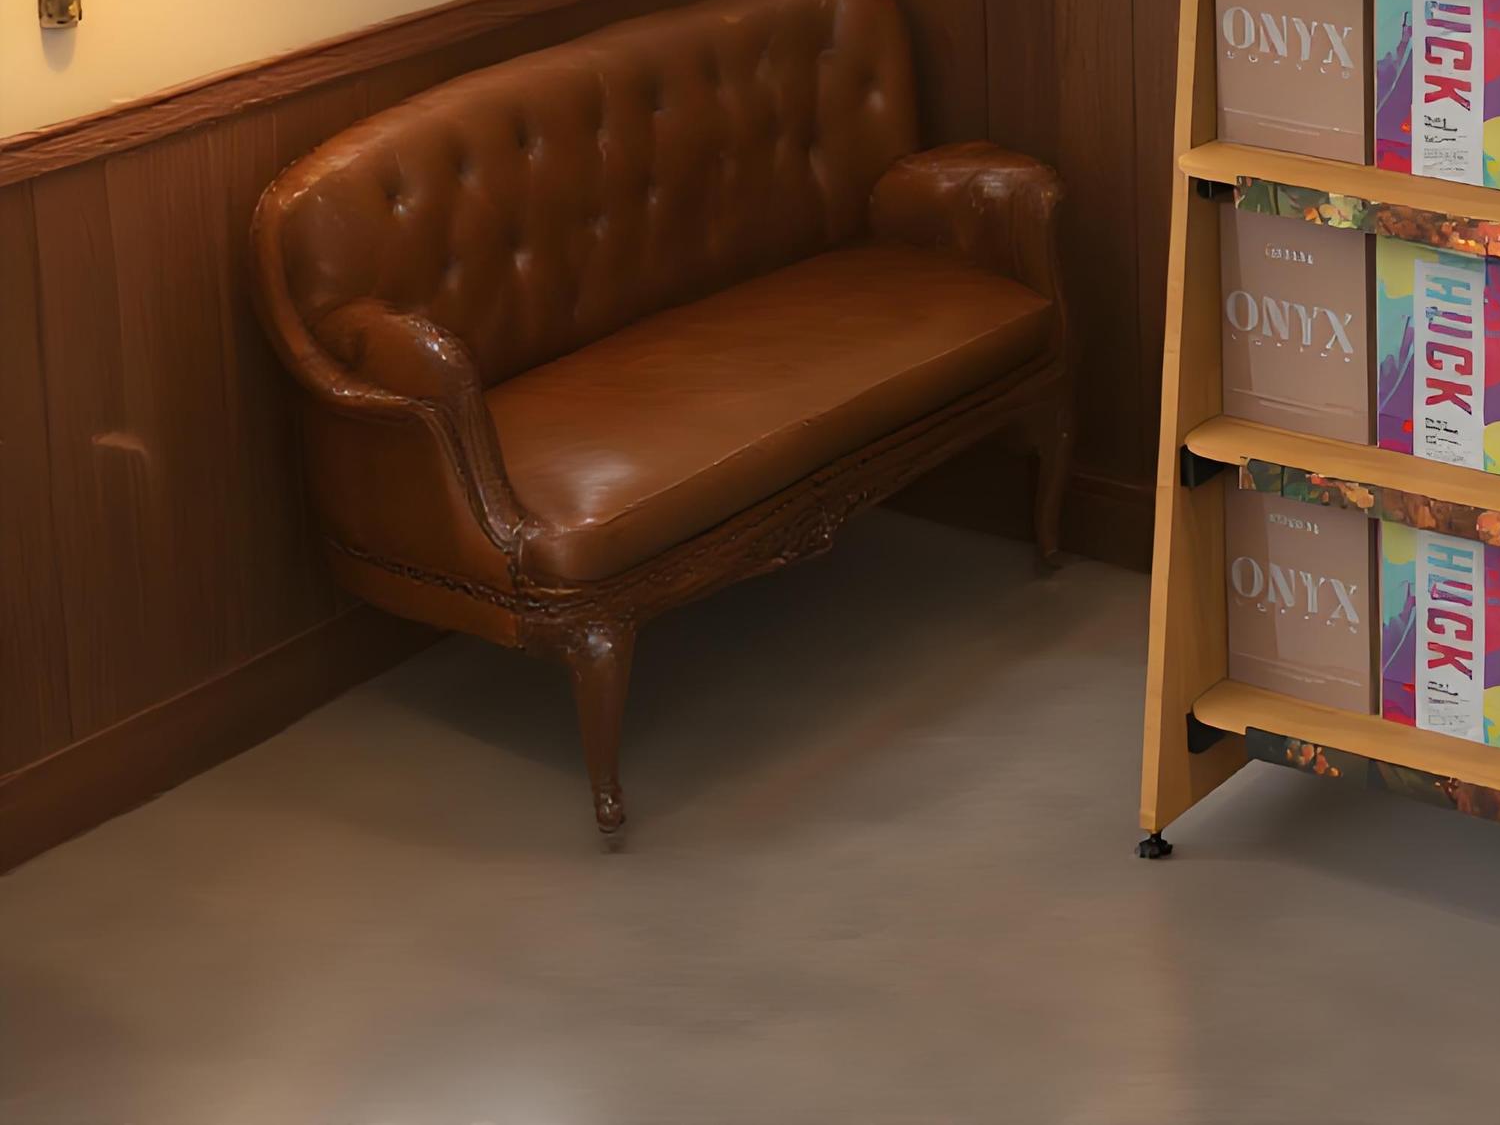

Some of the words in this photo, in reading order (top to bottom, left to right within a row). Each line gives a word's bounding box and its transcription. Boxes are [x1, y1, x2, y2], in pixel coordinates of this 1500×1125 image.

[1222, 6, 1354, 69] ONYX
[1226, 290, 1354, 354] ONYX
[1425, 275, 1473, 416] HUCK
[1231, 556, 1360, 624] ONYX
[1427, 542, 1474, 681] HUCK
